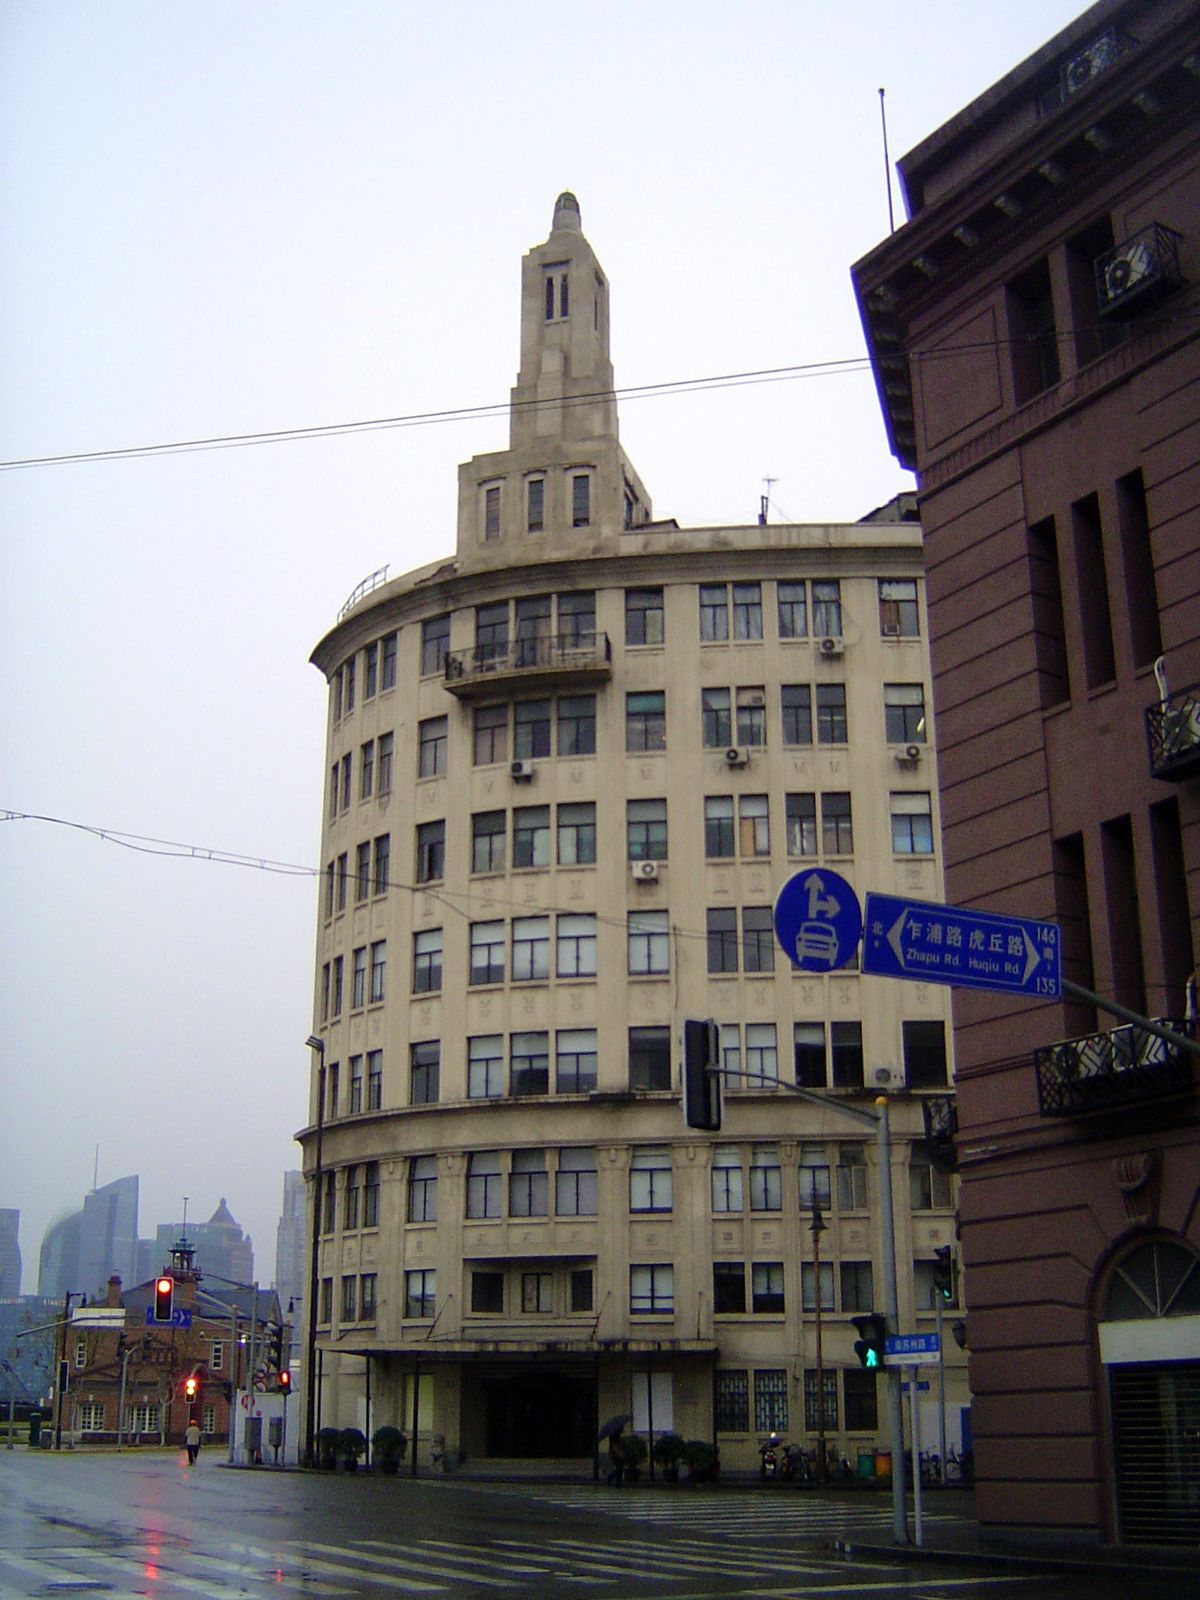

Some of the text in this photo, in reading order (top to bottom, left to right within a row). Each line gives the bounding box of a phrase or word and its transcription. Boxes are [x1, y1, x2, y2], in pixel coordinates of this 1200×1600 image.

[906, 919, 1022, 956] 乍浦路 虎丘路
[1037, 927, 1055, 944] 146
[907, 948, 939, 965] Zhapu
[969, 957, 999, 973] Huqiu
[1037, 977, 1056, 994] 135
